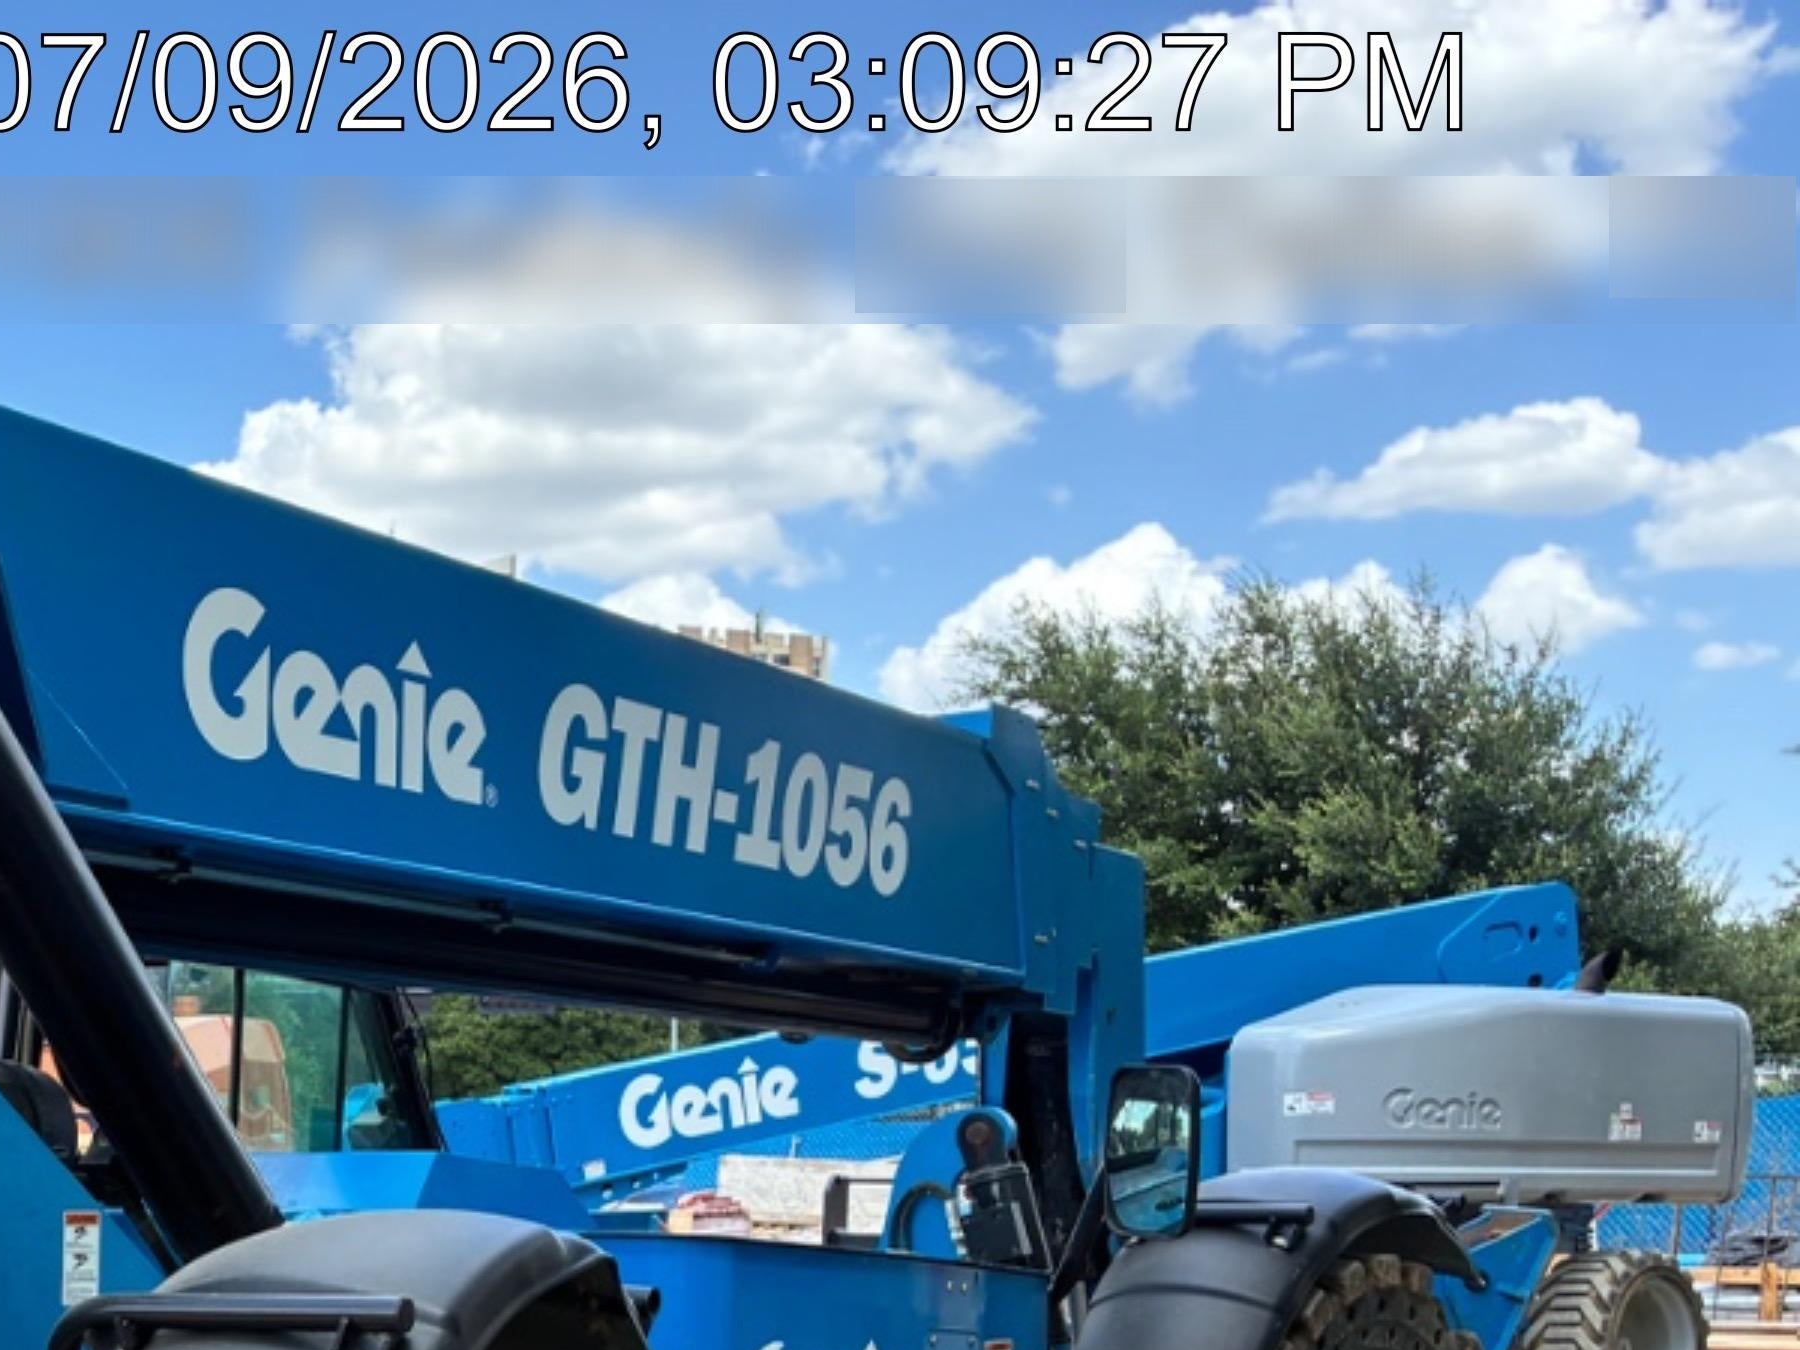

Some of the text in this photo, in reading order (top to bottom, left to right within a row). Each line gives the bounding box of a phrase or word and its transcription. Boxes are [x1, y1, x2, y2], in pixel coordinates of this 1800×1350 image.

[182, 586, 913, 898] Genie GTH-1056
[618, 1056, 800, 1149] Genie
[1383, 1087, 1503, 1130] Genie
